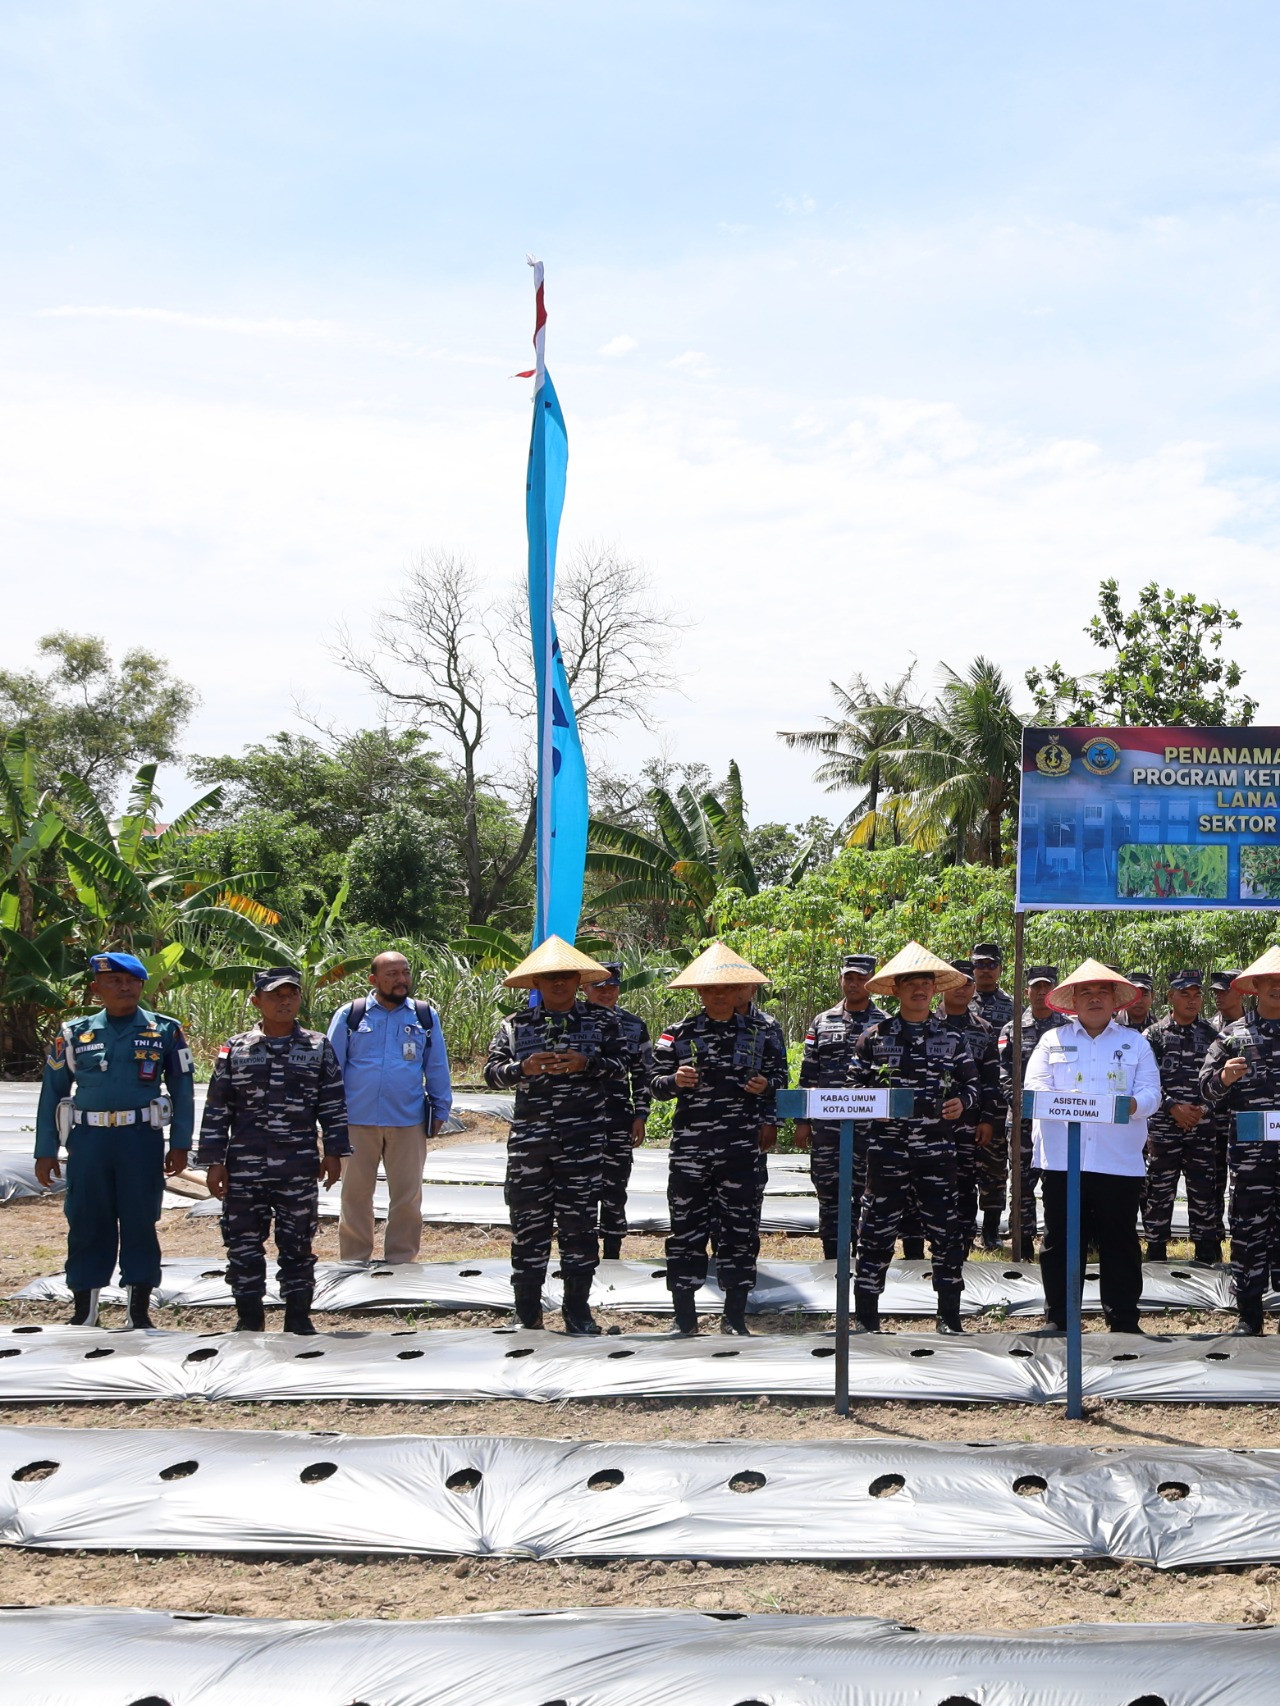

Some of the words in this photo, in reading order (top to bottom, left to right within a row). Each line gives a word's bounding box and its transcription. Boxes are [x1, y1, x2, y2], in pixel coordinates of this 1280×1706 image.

[1132, 768, 1238, 786] PROGRAM
[1199, 815, 1277, 833] SEKTOR
[134, 1039, 150, 1047] TNI
[152, 1041, 163, 1049] AL
[1053, 1097, 1088, 1106] ASISTEN
[1049, 1108, 1072, 1116] KOTA
[1073, 1109, 1099, 1118] DUMAI
